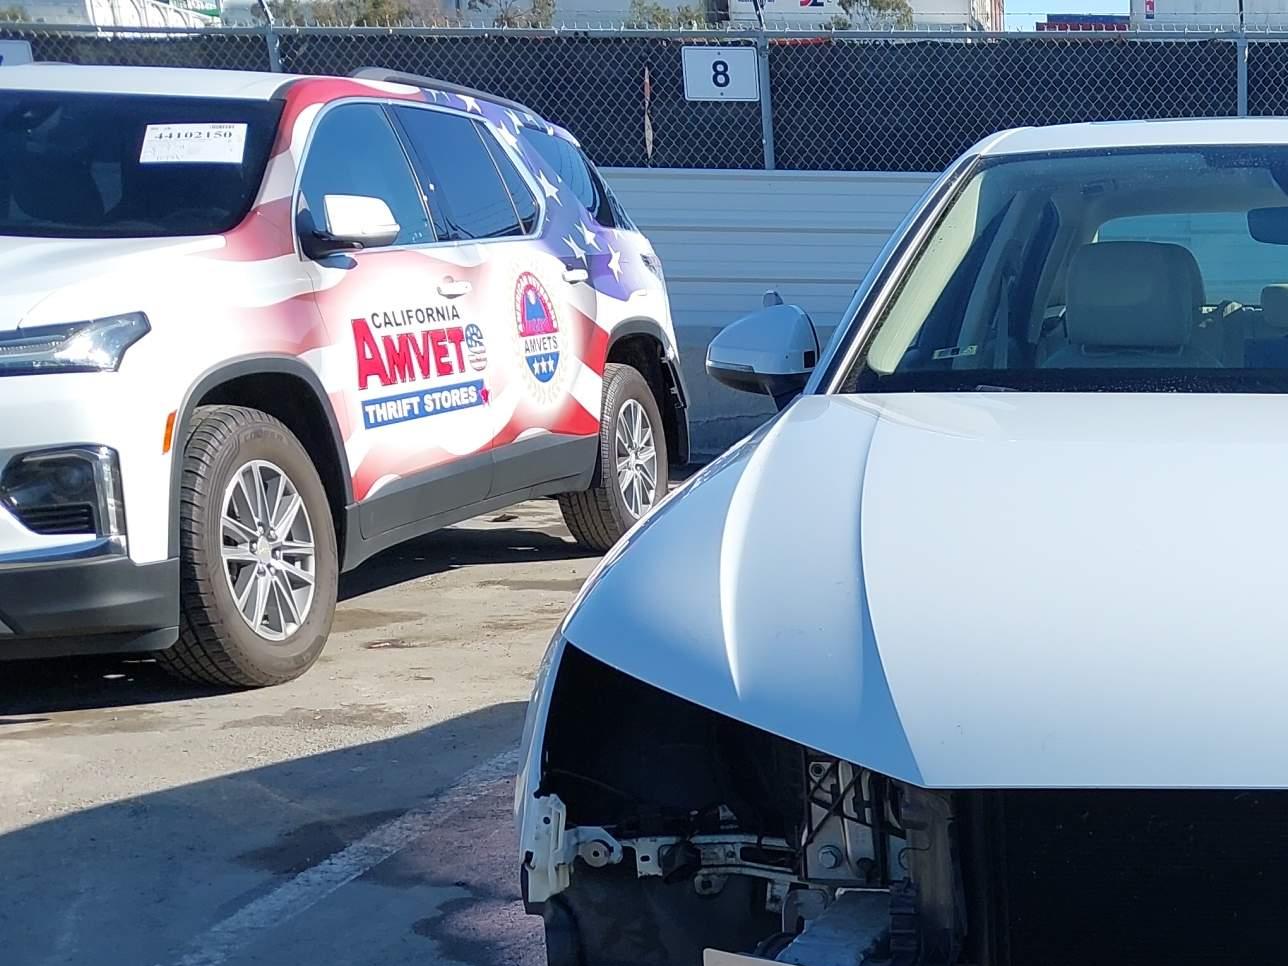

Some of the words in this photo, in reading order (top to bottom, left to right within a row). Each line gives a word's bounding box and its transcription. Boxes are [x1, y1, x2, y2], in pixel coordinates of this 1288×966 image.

[712, 60, 730, 87] 8
[155, 131, 233, 139] 44102150
[371, 305, 460, 328] CALIFORNIA
[351, 318, 488, 390] AMVETS
[524, 335, 559, 353] AMVETS
[365, 396, 420, 424] THRIFT
[424, 385, 477, 412] STORES
